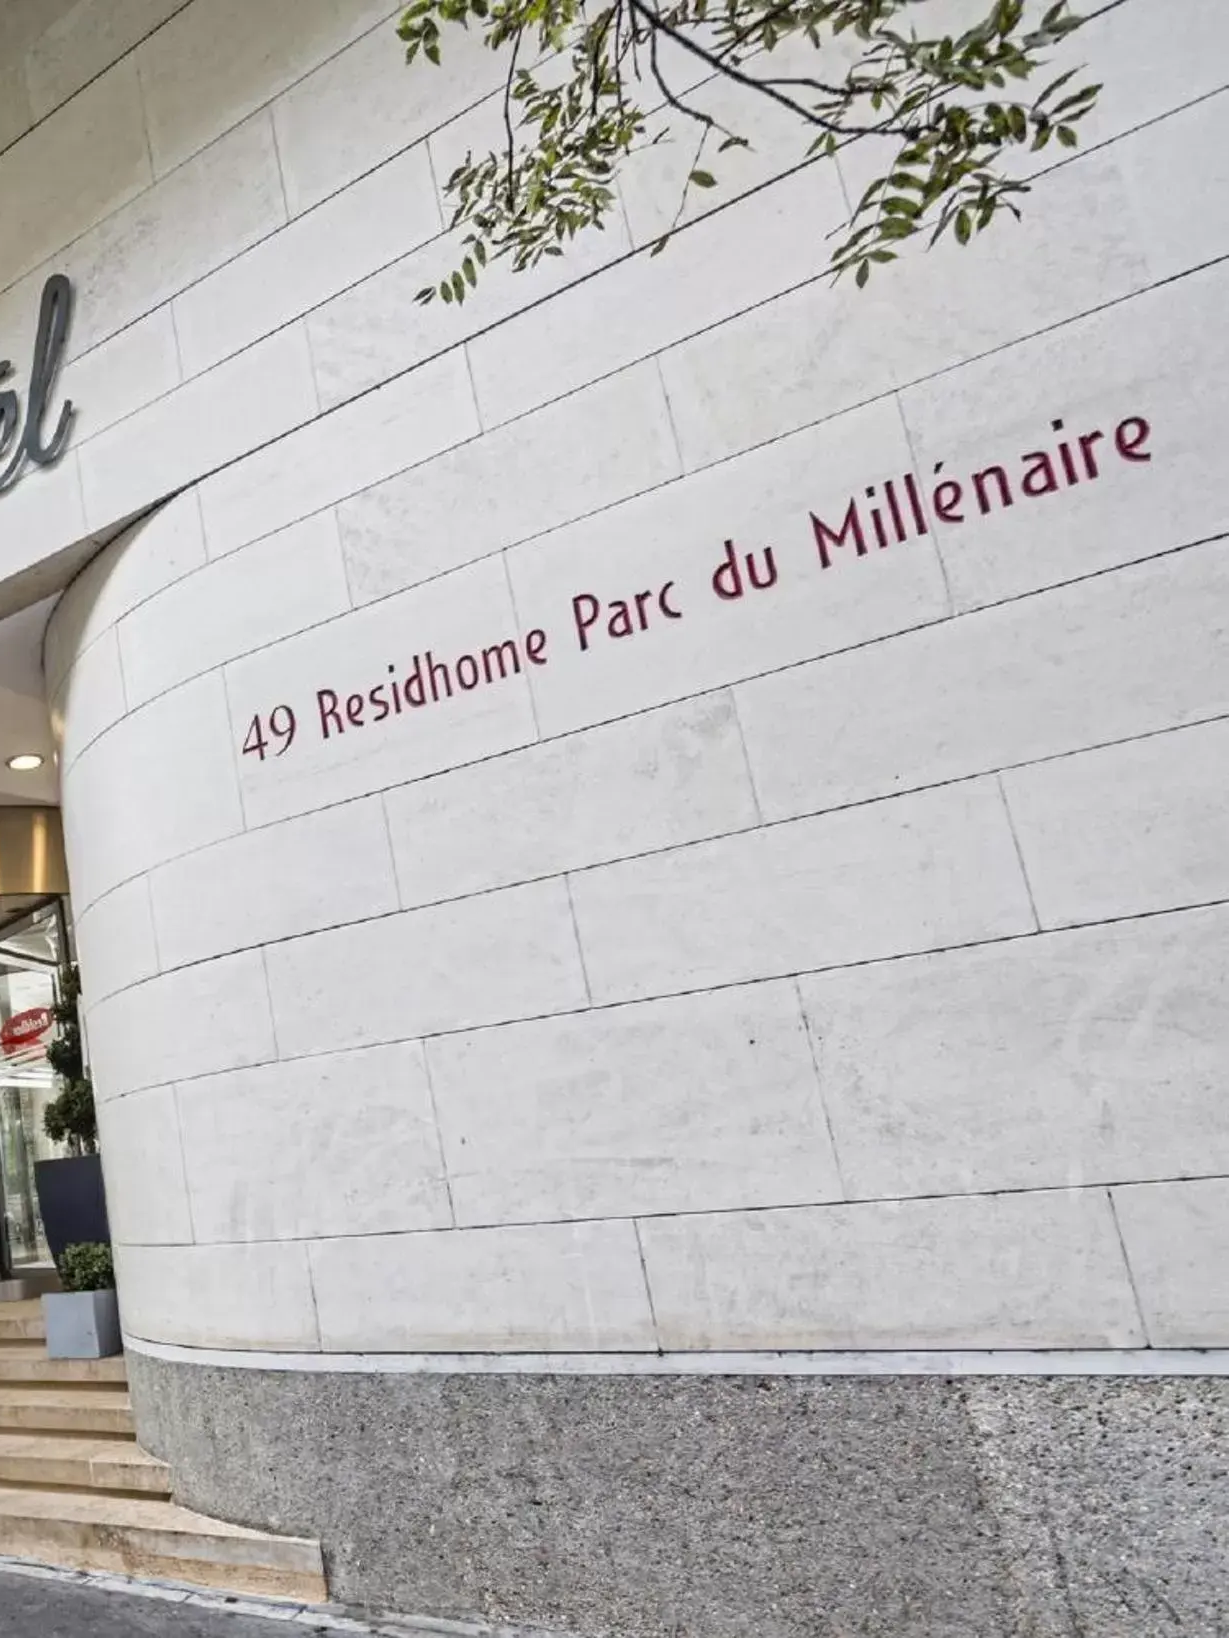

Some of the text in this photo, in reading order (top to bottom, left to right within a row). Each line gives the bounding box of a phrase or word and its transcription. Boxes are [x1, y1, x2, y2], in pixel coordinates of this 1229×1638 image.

[241, 415, 1152, 763] 49 Residhome Parc du Millénaire
